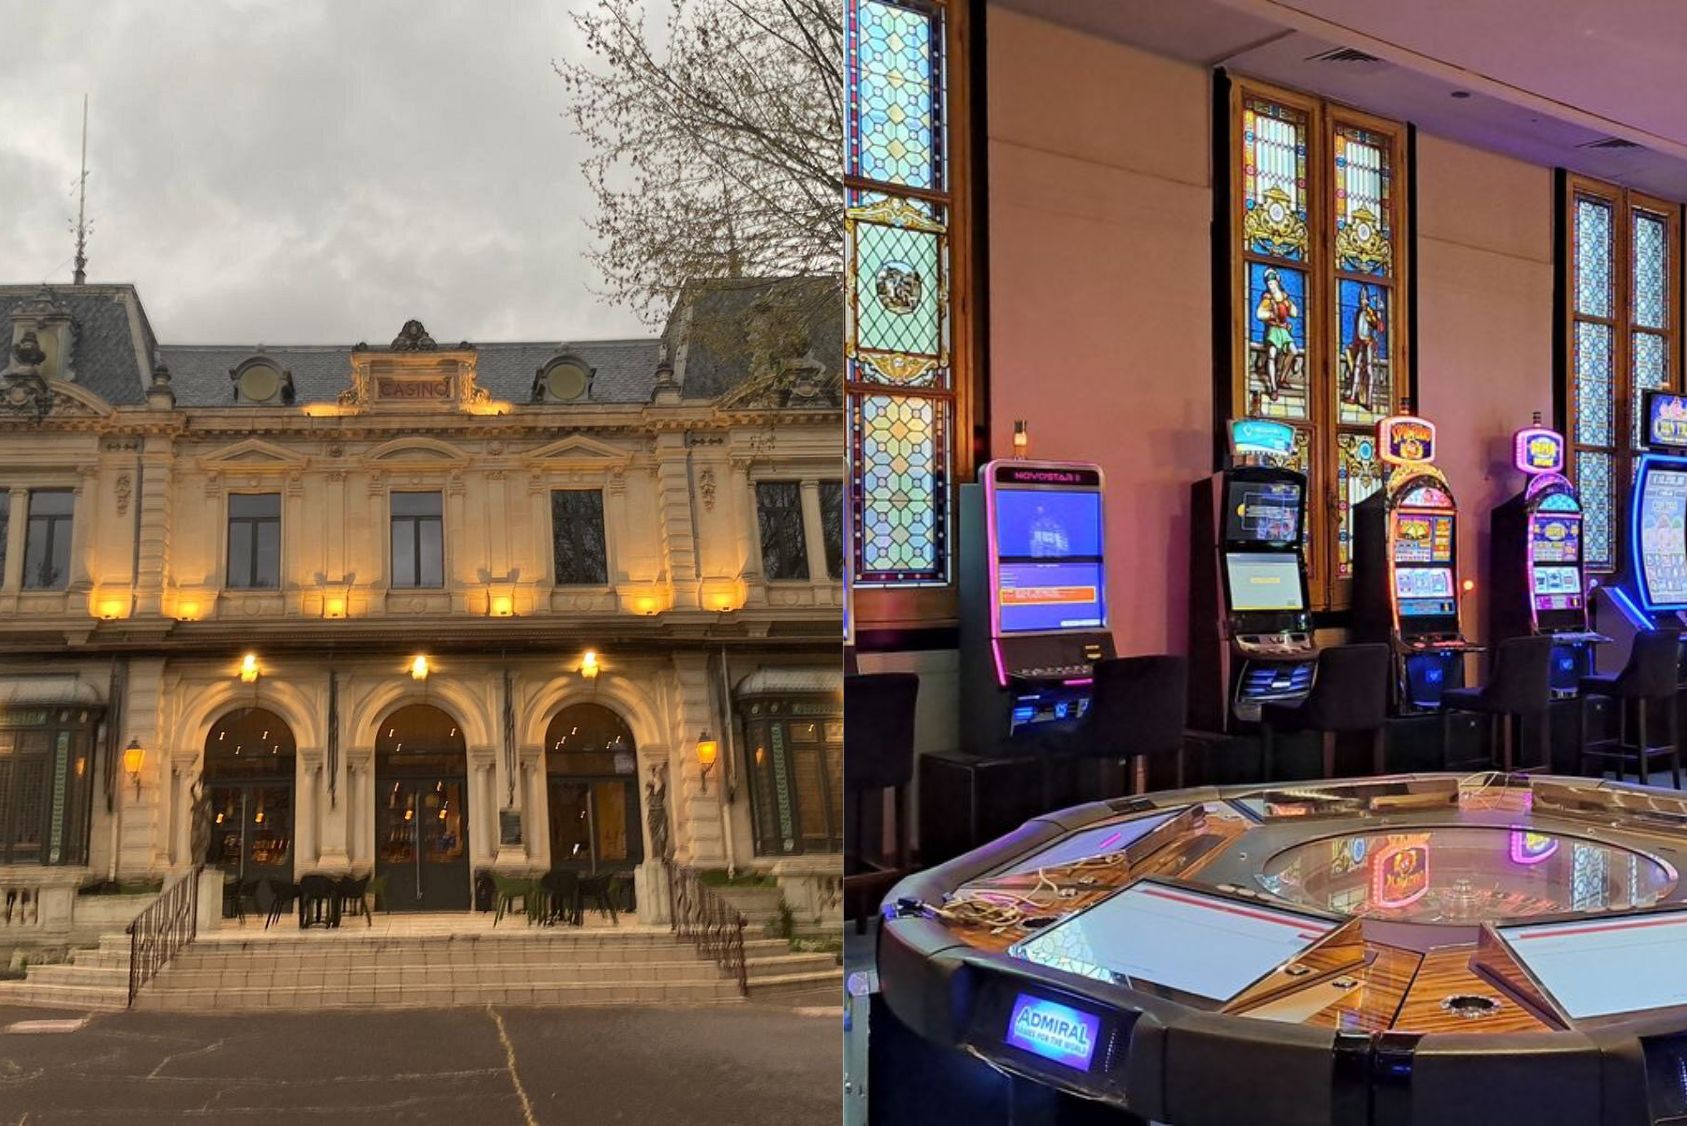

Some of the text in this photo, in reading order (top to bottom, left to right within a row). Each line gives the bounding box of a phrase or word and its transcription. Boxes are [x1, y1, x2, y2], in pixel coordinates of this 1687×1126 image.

[381, 382, 447, 398] CASINO
[1014, 471, 1073, 481] NOVOSTAR
[1017, 1007, 1088, 1045] ADMIRAL
[1038, 1032, 1050, 1041] FOR
[1050, 1036, 1062, 1047] THE
